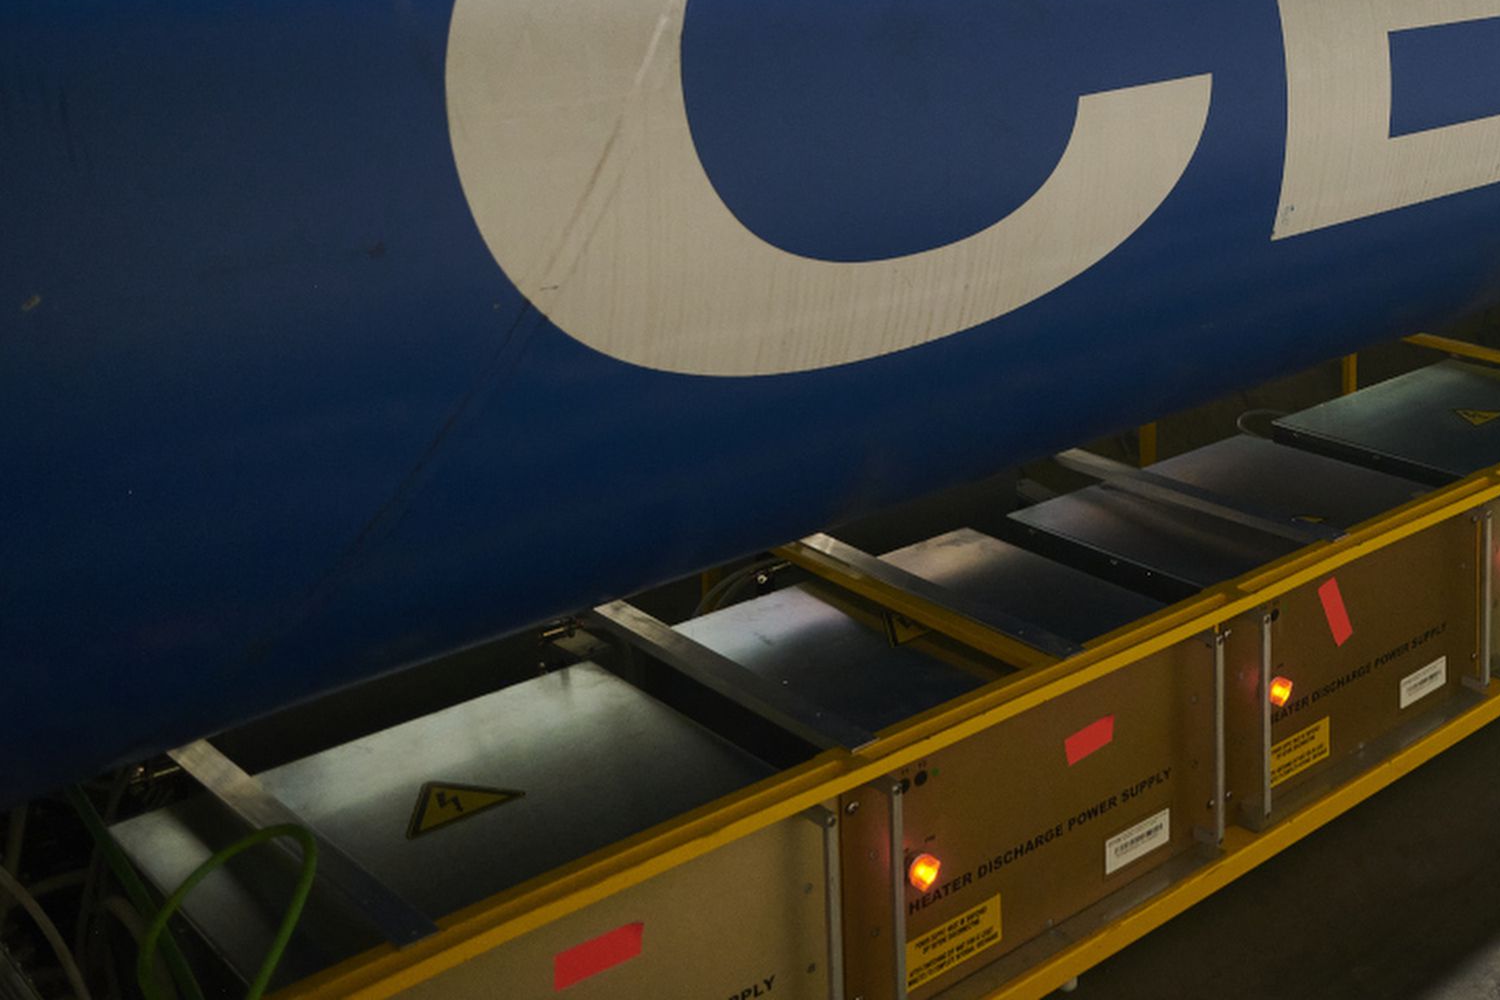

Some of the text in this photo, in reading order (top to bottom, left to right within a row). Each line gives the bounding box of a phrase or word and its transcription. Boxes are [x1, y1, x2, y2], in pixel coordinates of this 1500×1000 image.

[1311, 661, 1372, 703] DISCHARGE
[1374, 641, 1409, 670] POWER
[1411, 621, 1447, 649] SUPPLY
[908, 873, 973, 915] HEATER
[976, 825, 1064, 880] DISCHARGE
[1067, 795, 1118, 832] POWER
[1121, 767, 1173, 802] SUPPLY
